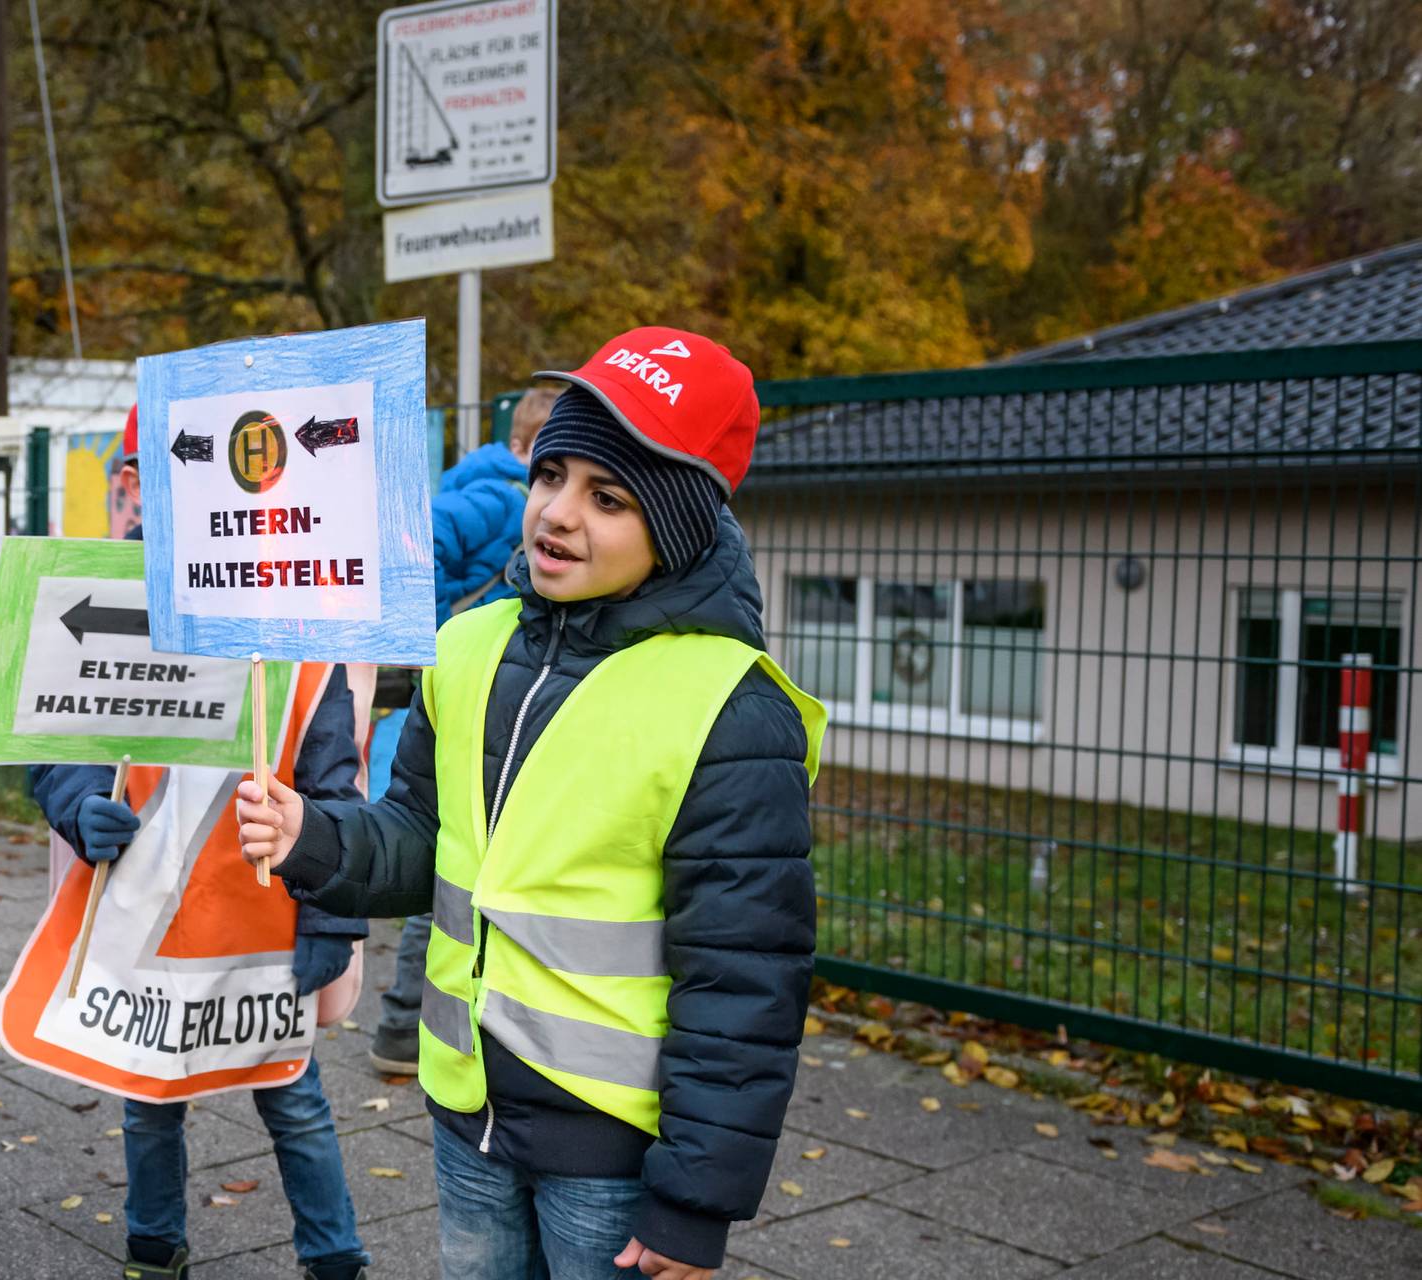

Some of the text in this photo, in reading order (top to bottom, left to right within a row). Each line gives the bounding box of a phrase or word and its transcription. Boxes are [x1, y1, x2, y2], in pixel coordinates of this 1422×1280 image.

[487, 34, 515, 54] FÜR
[519, 31, 540, 50] DIE
[443, 60, 527, 87] FEUERWEHR
[444, 87, 526, 111] FREIHALTEN
[395, 215, 541, 257] Feuerwehrzufahrt
[604, 348, 683, 407] DEKRA
[209, 506, 321, 538] ELTERN-
[187, 558, 364, 589] HALTESTELLE
[78, 659, 196, 683] ELTERN-
[35, 694, 226, 721] HALTESTELLE
[79, 986, 306, 1054] SCHÜLERLOTSE
